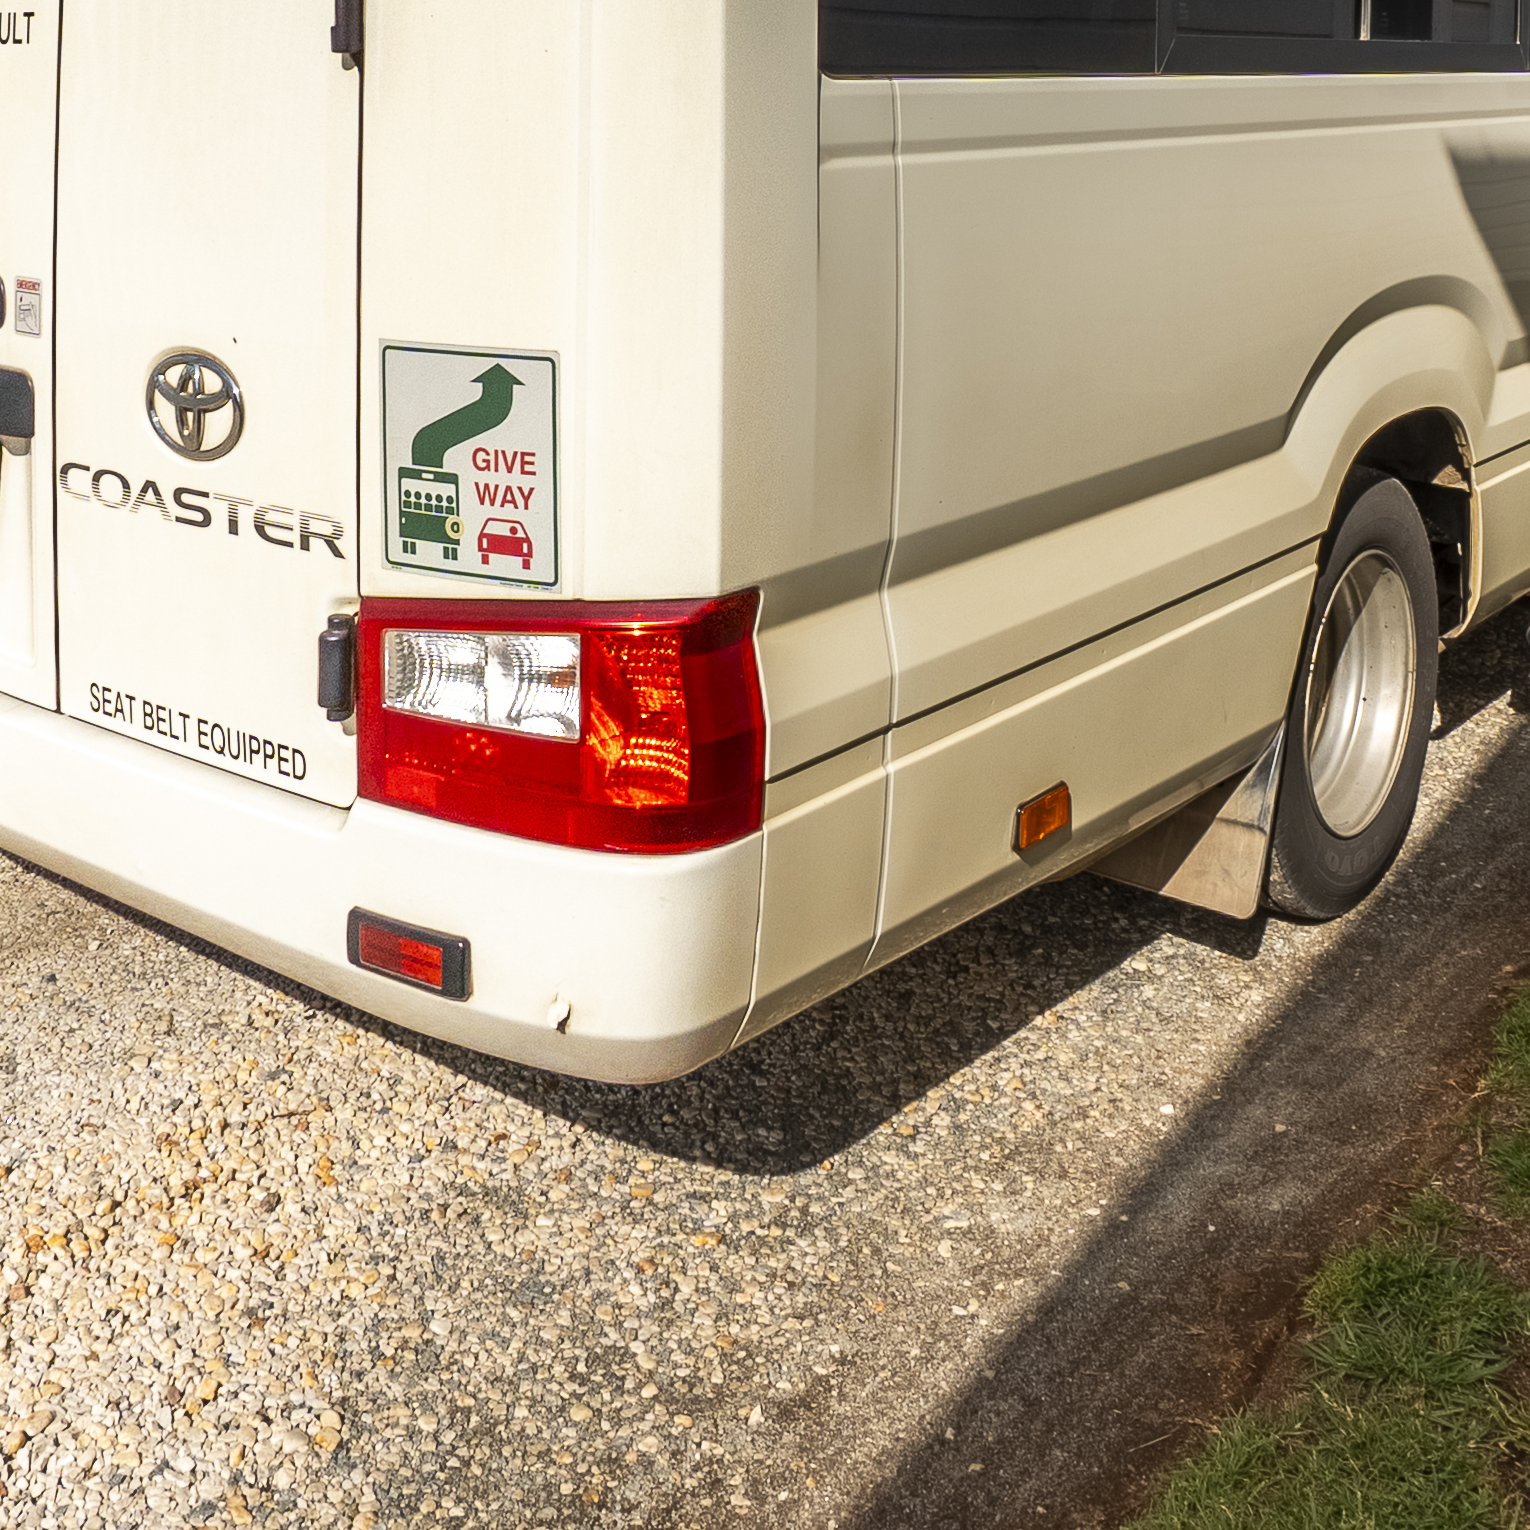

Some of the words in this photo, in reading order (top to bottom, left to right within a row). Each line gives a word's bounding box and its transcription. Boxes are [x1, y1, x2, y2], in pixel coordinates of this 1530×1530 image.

[471, 446, 537, 477] GIVE
[59, 462, 346, 560] COASTER
[474, 481, 535, 511] WAY
[90, 682, 136, 725] SEAT
[142, 700, 190, 743] BELT
[197, 717, 307, 781] EQUIPPED
